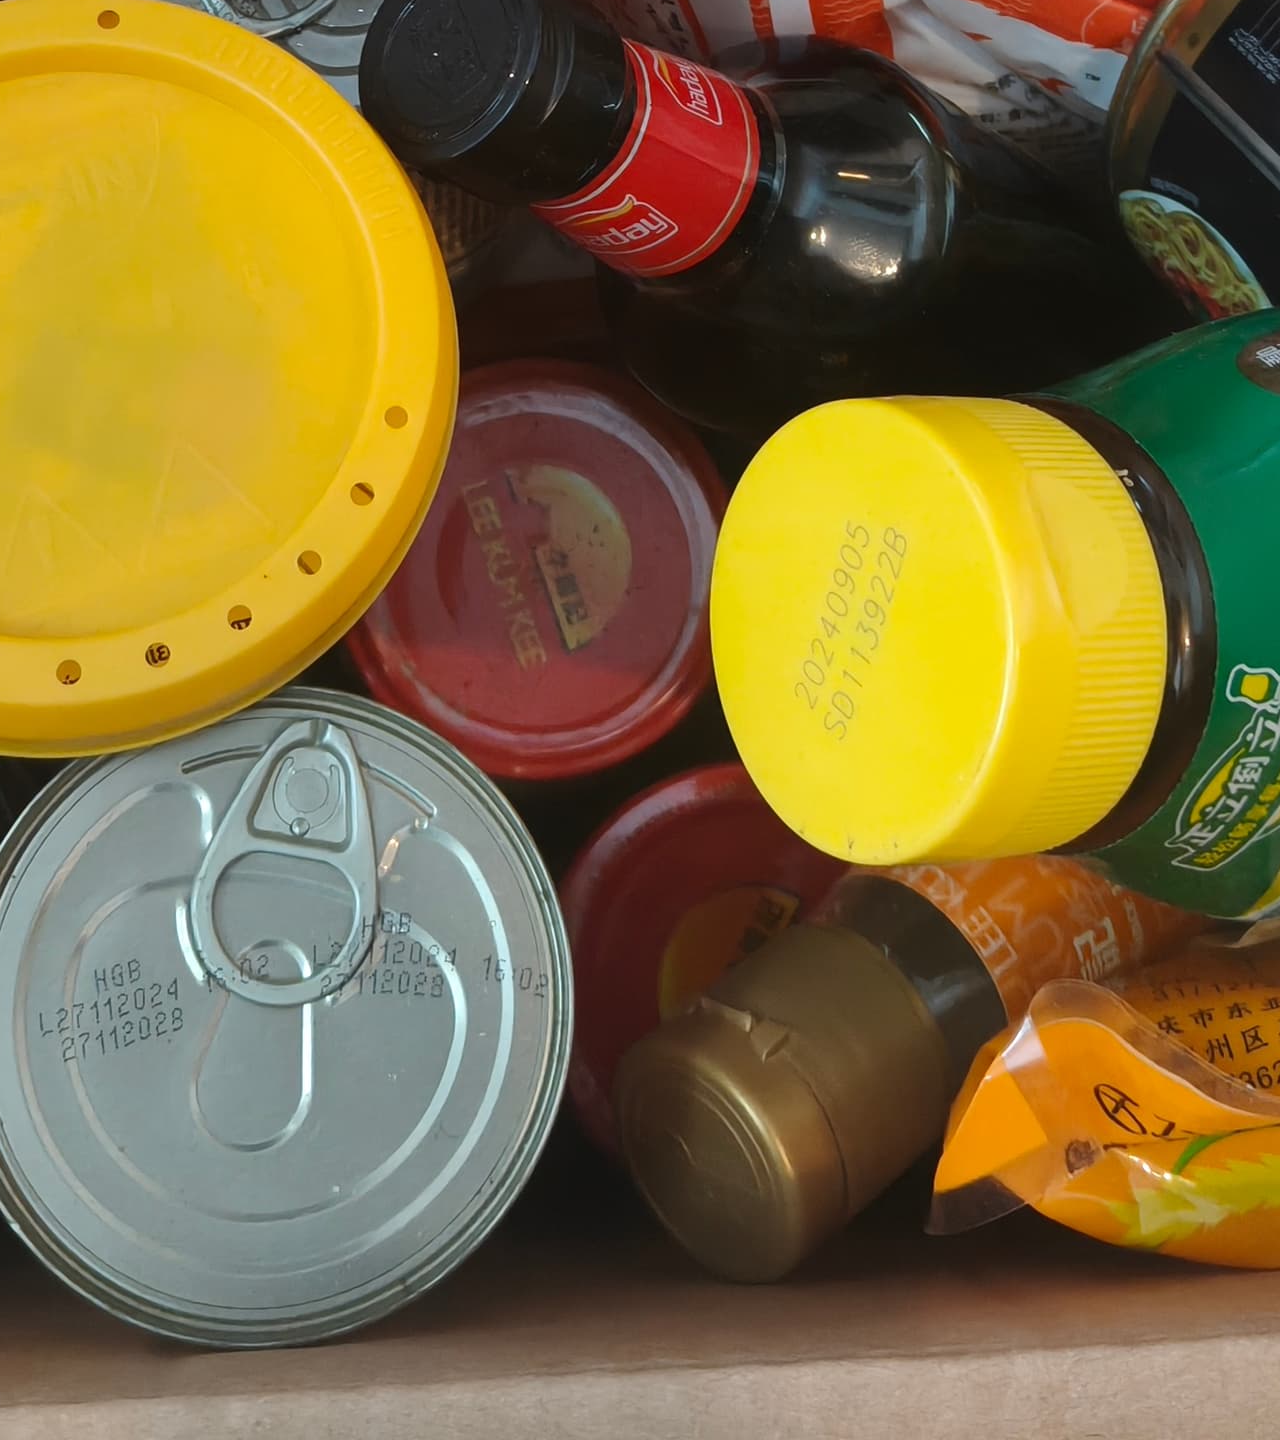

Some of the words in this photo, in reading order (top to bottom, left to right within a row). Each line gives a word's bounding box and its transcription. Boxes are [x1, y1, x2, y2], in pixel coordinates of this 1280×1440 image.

[584, 212, 669, 247] aday
[793, 519, 873, 712] 20240905
[93, 958, 142, 993] HGB
[38, 977, 181, 1037] L27112024
